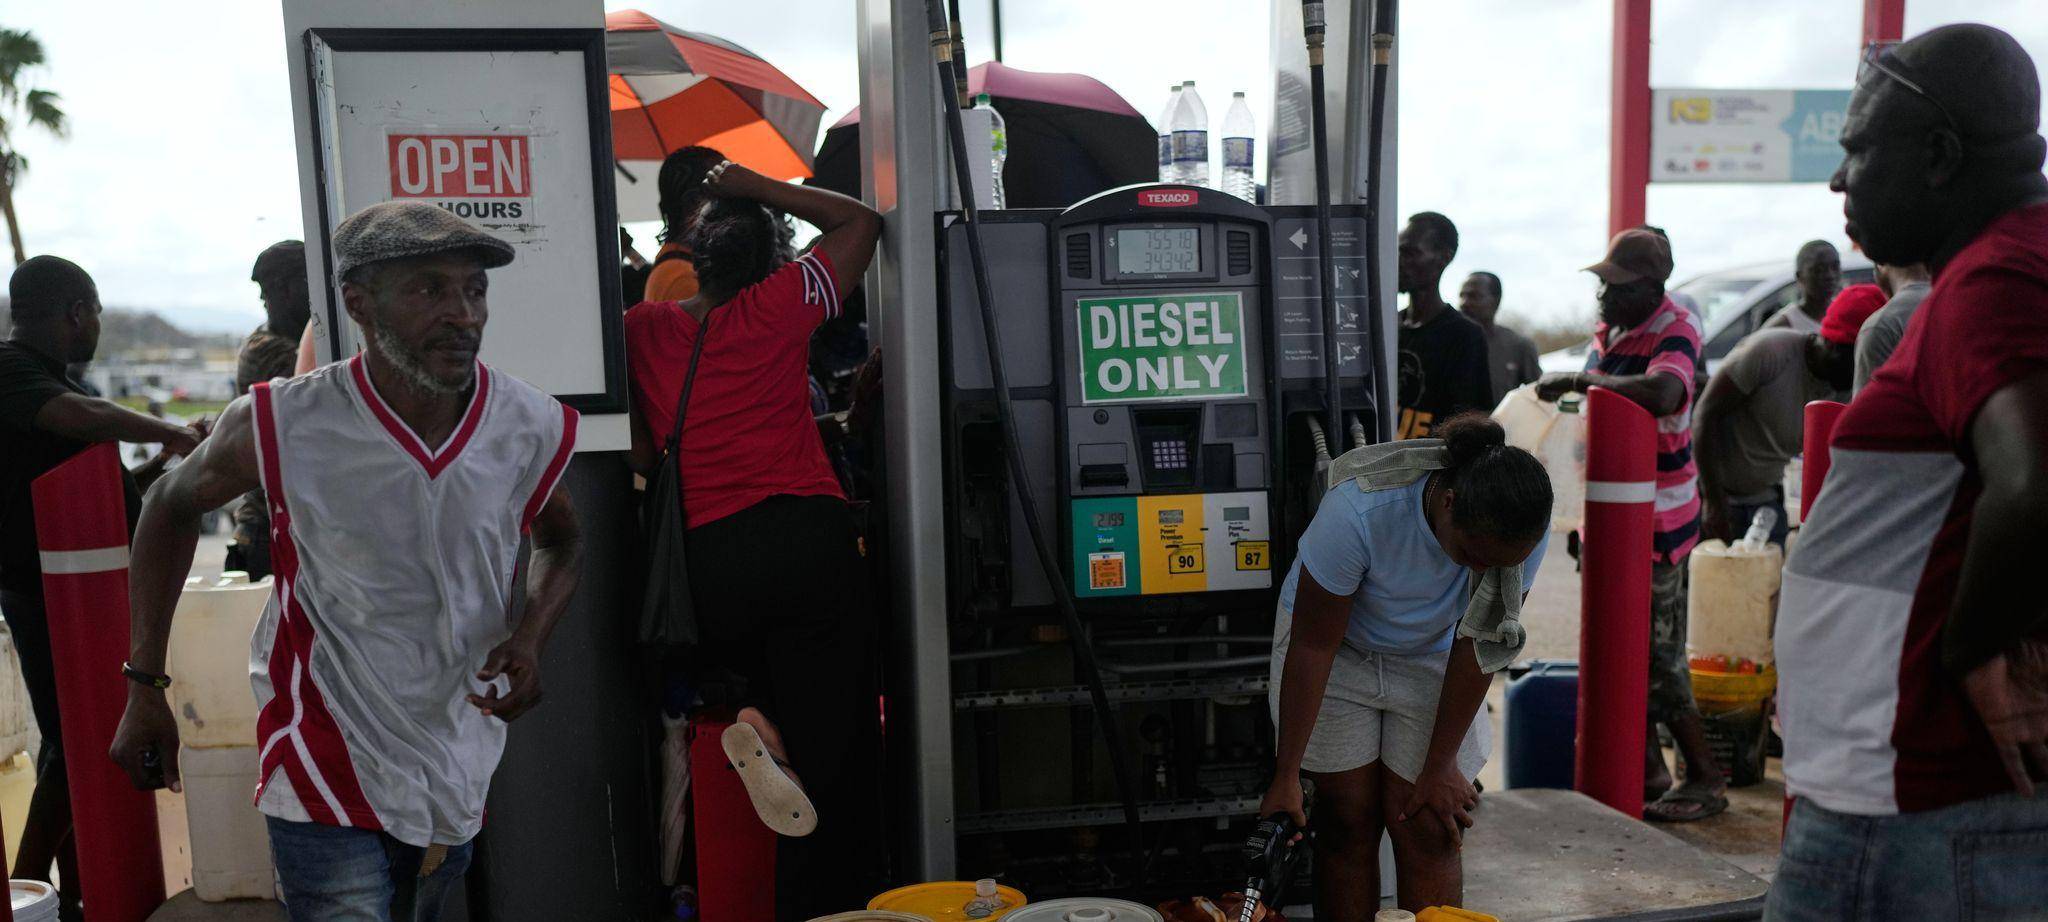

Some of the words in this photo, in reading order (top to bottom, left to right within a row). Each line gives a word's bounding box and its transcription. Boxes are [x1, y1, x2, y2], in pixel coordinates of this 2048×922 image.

[398, 138, 524, 194] OPEN
[1147, 193, 1190, 203] TEXACO
[1109, 238, 1116, 247] $
[1090, 301, 1234, 350] DIESEL
[1097, 354, 1230, 393] ONLY
[1178, 555, 1195, 568] 90
[1245, 552, 1261, 566] 87
